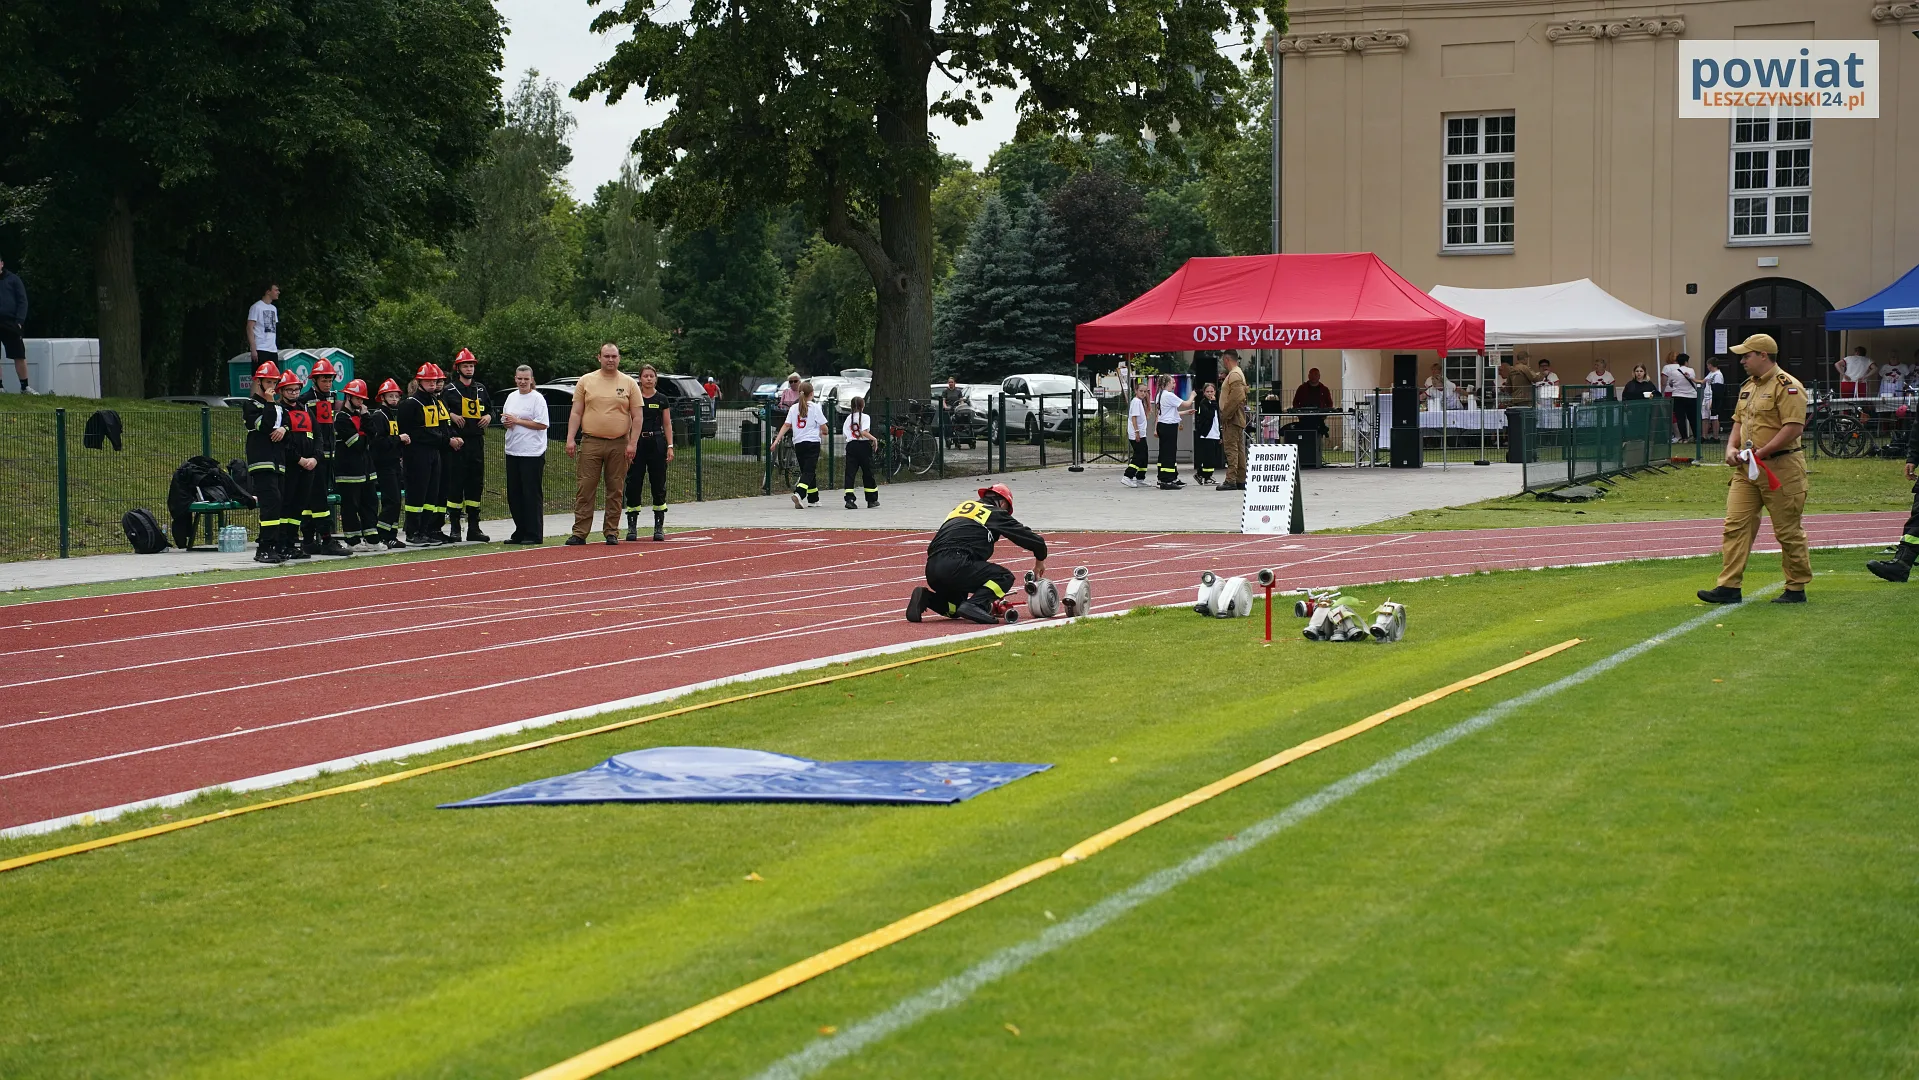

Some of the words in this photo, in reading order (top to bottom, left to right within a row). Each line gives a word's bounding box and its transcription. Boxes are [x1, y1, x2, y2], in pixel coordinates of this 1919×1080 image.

[1193, 325, 1232, 342] OSP
[1238, 324, 1321, 345] Rydzyna
[321, 403, 330, 420] 3
[467, 400, 477, 416] 9
[295, 412, 308, 429] 2
[428, 408, 435, 425] 7
[1255, 453, 1288, 461] PROSIMY
[1264, 463, 1290, 471] BIEGAĆ
[1251, 474, 1261, 482] PO
[1263, 474, 1288, 482] WEWN.
[1258, 485, 1280, 493] TORZE
[958, 502, 976, 515] 9
